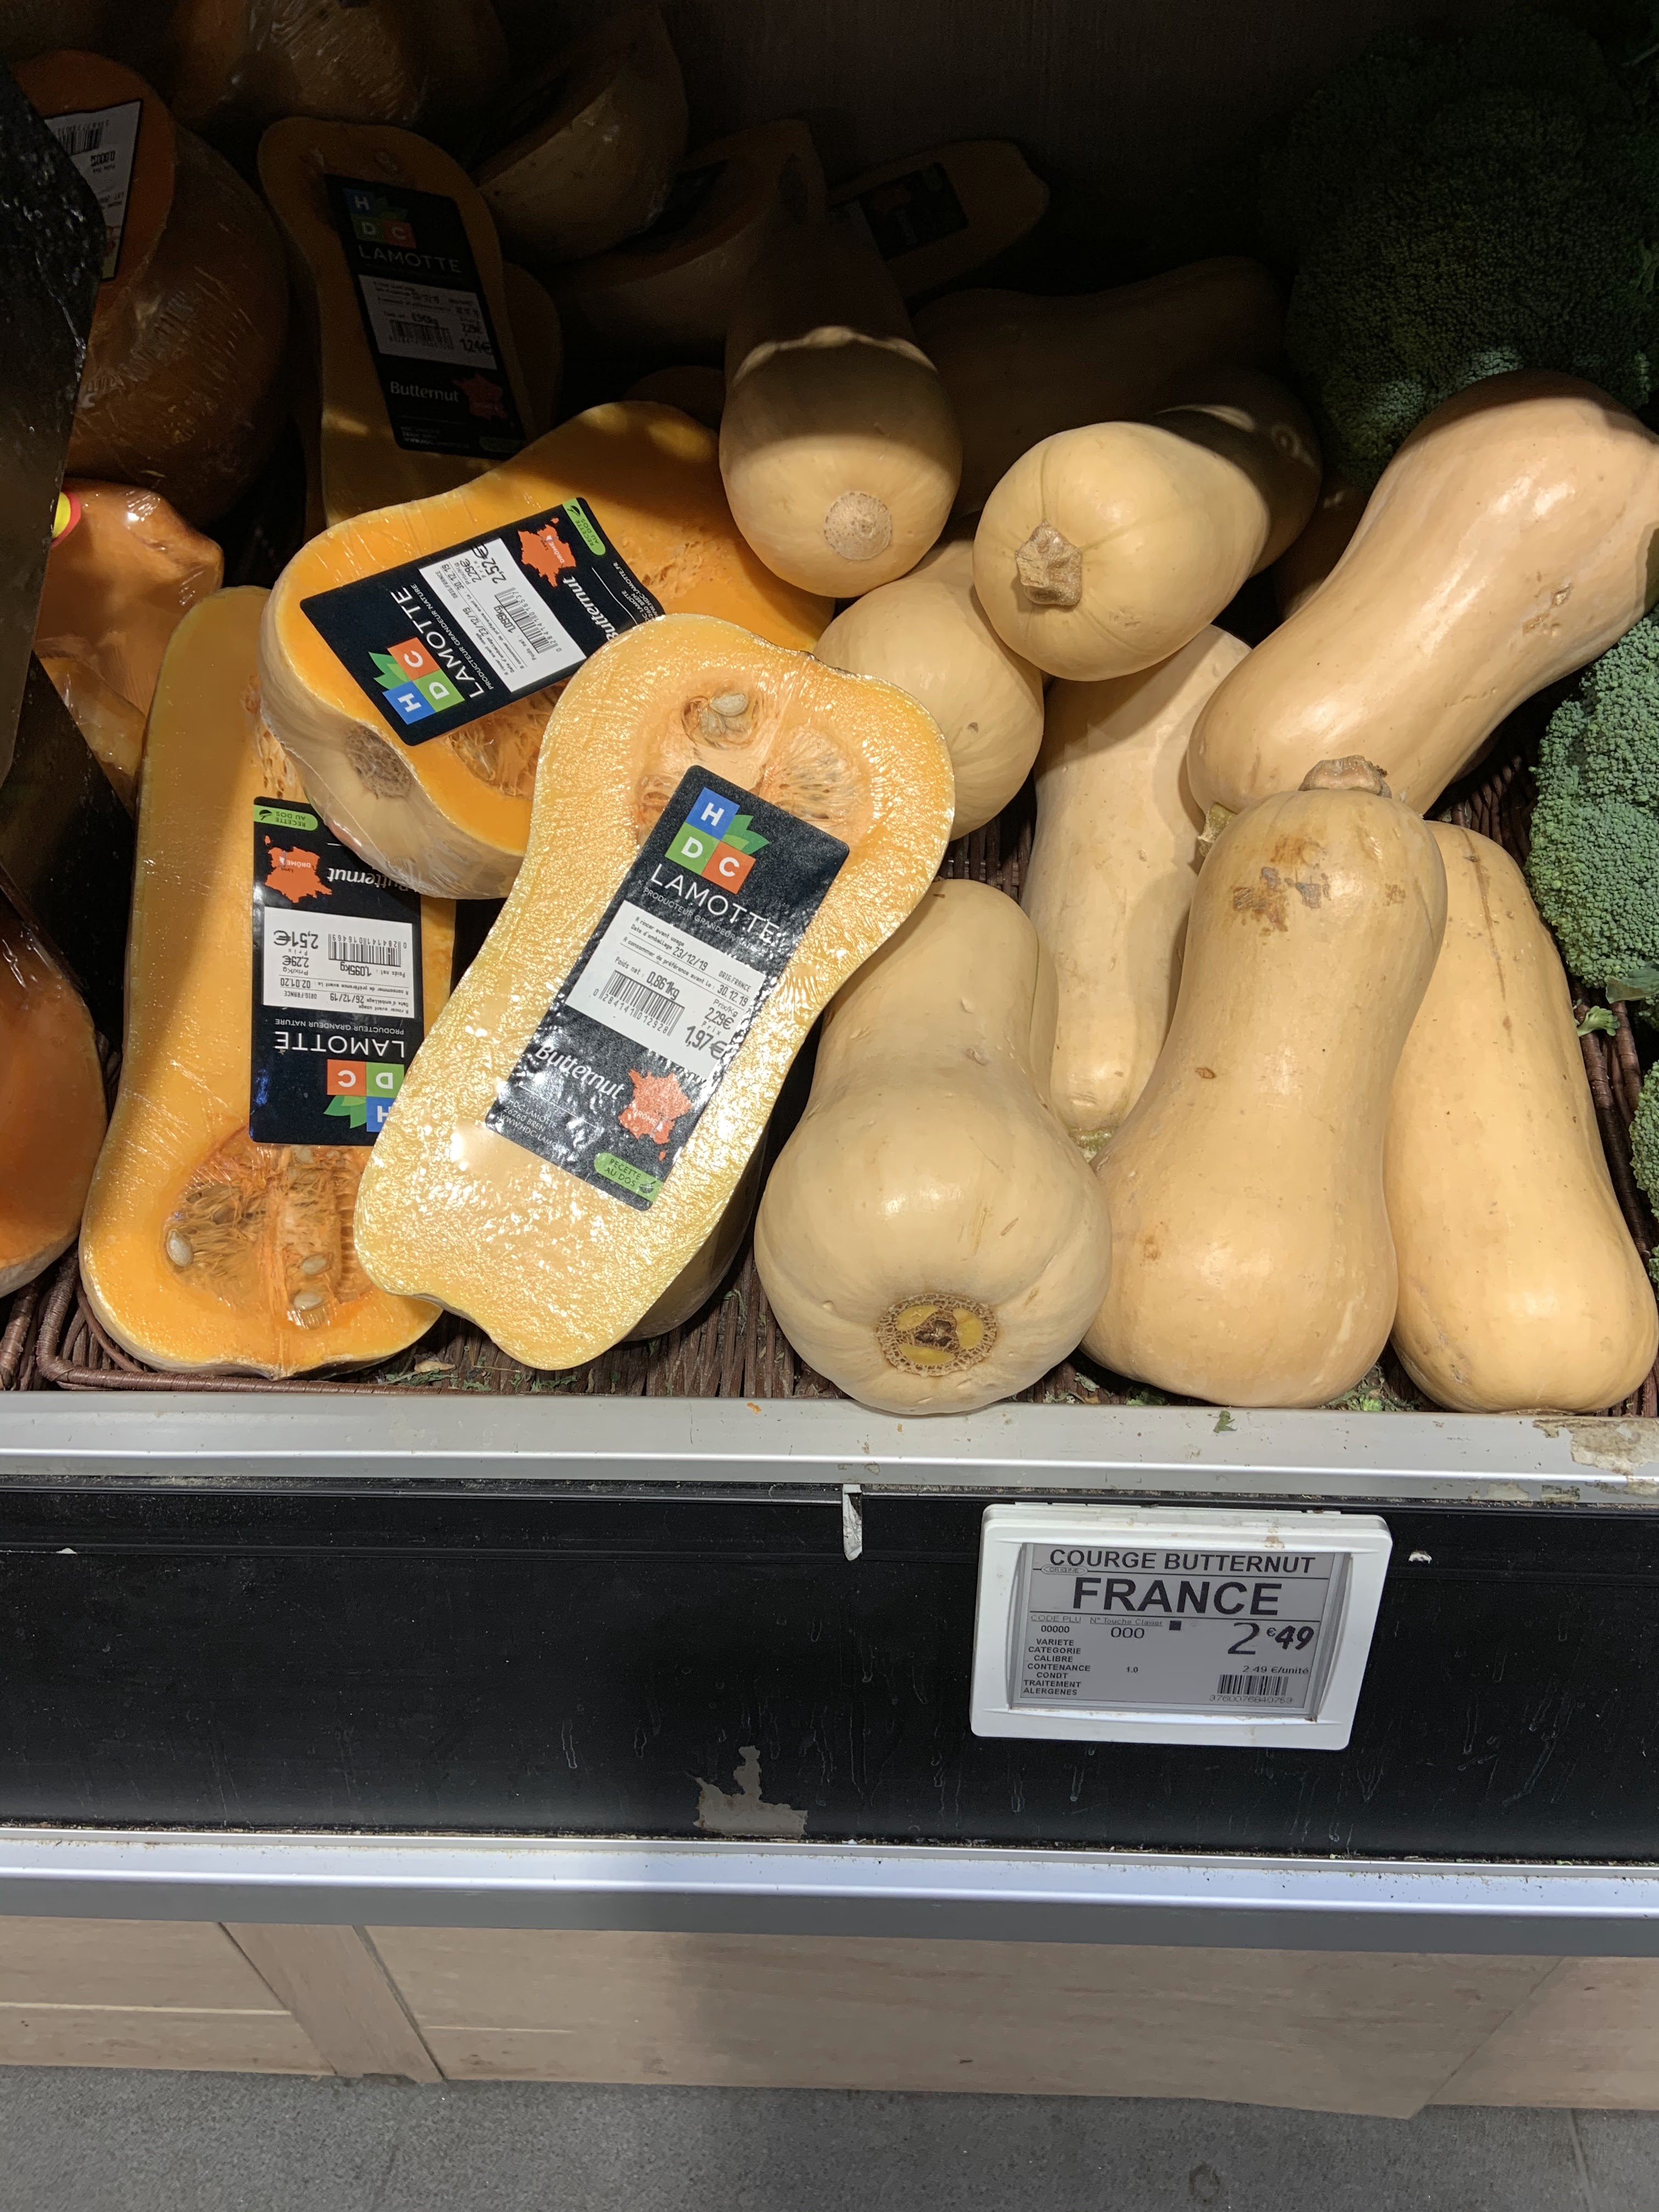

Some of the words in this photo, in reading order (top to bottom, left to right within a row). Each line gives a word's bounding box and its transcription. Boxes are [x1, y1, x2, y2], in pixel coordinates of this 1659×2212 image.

[353, 195, 371, 211] H
[360, 221, 378, 236] D
[389, 225, 407, 240] C
[358, 245, 462, 274] LAMOTTE
[389, 380, 460, 403] Butternut
[573, 519, 596, 546] RECETTE
[579, 518, 593, 533] DOS
[589, 534, 600, 544] AU
[546, 541, 567, 563] DRÔME
[452, 562, 472, 584] Prix/Kg
[458, 557, 483, 583] 2,29€
[468, 542, 509, 584] 2,52€
[440, 563, 465, 590] 30.12.19
[410, 583, 433, 610] NATURE
[469, 599, 482, 612] avant
[561, 573, 620, 641] Butternut
[620, 588, 644, 613] LAMOTTE
[630, 592, 645, 606] BREN
[461, 606, 489, 636] 23/12/19
[641, 612, 650, 621] DC
[430, 610, 461, 646] GRANDEUR
[474, 632, 487, 645] usage
[390, 586, 485, 698] LAMOTTE
[484, 646, 495, 658] avant
[518, 638, 527, 647] net
[400, 648, 426, 669] C
[501, 642, 521, 664] consommer
[524, 647, 537, 660] Poids
[458, 646, 494, 690] PRODUCTEUR
[494, 658, 506, 671] rincer
[504, 662, 515, 673] Date
[425, 679, 450, 699] D
[397, 692, 421, 712] H
[275, 817, 305, 827] RECETTE
[699, 802, 725, 826] H
[286, 860, 311, 868] DRÔME
[680, 836, 706, 861] D
[715, 854, 742, 879] C
[648, 862, 780, 944] LAMOTTE
[642, 887, 695, 919] PRODUCTEUR
[692, 913, 736, 941] GRANDEUR
[273, 928, 318, 949] 2,51€
[640, 919, 654, 930] rincer
[654, 928, 670, 939] avant
[670, 936, 685, 947] usage
[630, 924, 643, 934] Date
[672, 946, 709, 972] 23/12/19
[282, 955, 308, 967] 2,29€
[283, 967, 308, 975] Prix/Kg
[340, 961, 371, 977] 1,095kg
[280, 978, 310, 988] 02.01.20
[614, 956, 631, 969] Poids
[630, 966, 641, 975] net
[644, 970, 682, 1001] 0,861kg
[627, 940, 655, 957] consommer
[662, 958, 690, 977] préférence
[689, 973, 705, 984] avant
[715, 984, 749, 1008] 30.12.19
[330, 992, 364, 1003] 26/12/19
[712, 998, 739, 1017] Prix/Kg
[275, 1018, 306, 1026] NATURE
[308, 1021, 351, 1030] GRANDEUR
[703, 1006, 735, 1031] 2,29€
[353, 1025, 404, 1035] PRODUCTEUR
[274, 1031, 404, 1058] LAMOTTE
[679, 1023, 728, 1063] 1,97€
[337, 1069, 356, 1087] C
[375, 1071, 393, 1088] D
[534, 1040, 626, 1101] Butternut
[503, 1105, 527, 1122] 26260
[526, 1118, 545, 1132] BREN
[507, 1098, 525, 1111] HDC
[524, 1107, 557, 1130] LAMOTTE
[604, 1166, 618, 1177] AU
[617, 1173, 636, 1187] DOS
[608, 1158, 641, 1181] RECETTE
[1049, 1549, 1156, 1568] COURGE
[1164, 1552, 1316, 1573] BUTTERNUT
[1073, 1576, 1282, 1616] FRANCE
[1041, 1625, 1070, 1633] 00000
[1110, 1627, 1145, 1638] 000
[1028, 1646, 1081, 1654] CATEGORIE
[1027, 1663, 1091, 1672] CONTENANCE
[1271, 1666, 1310, 1674] €/unité
[1023, 1679, 1081, 1688] TRAITEMENT
[1023, 1687, 1077, 1696] ALERGENES
